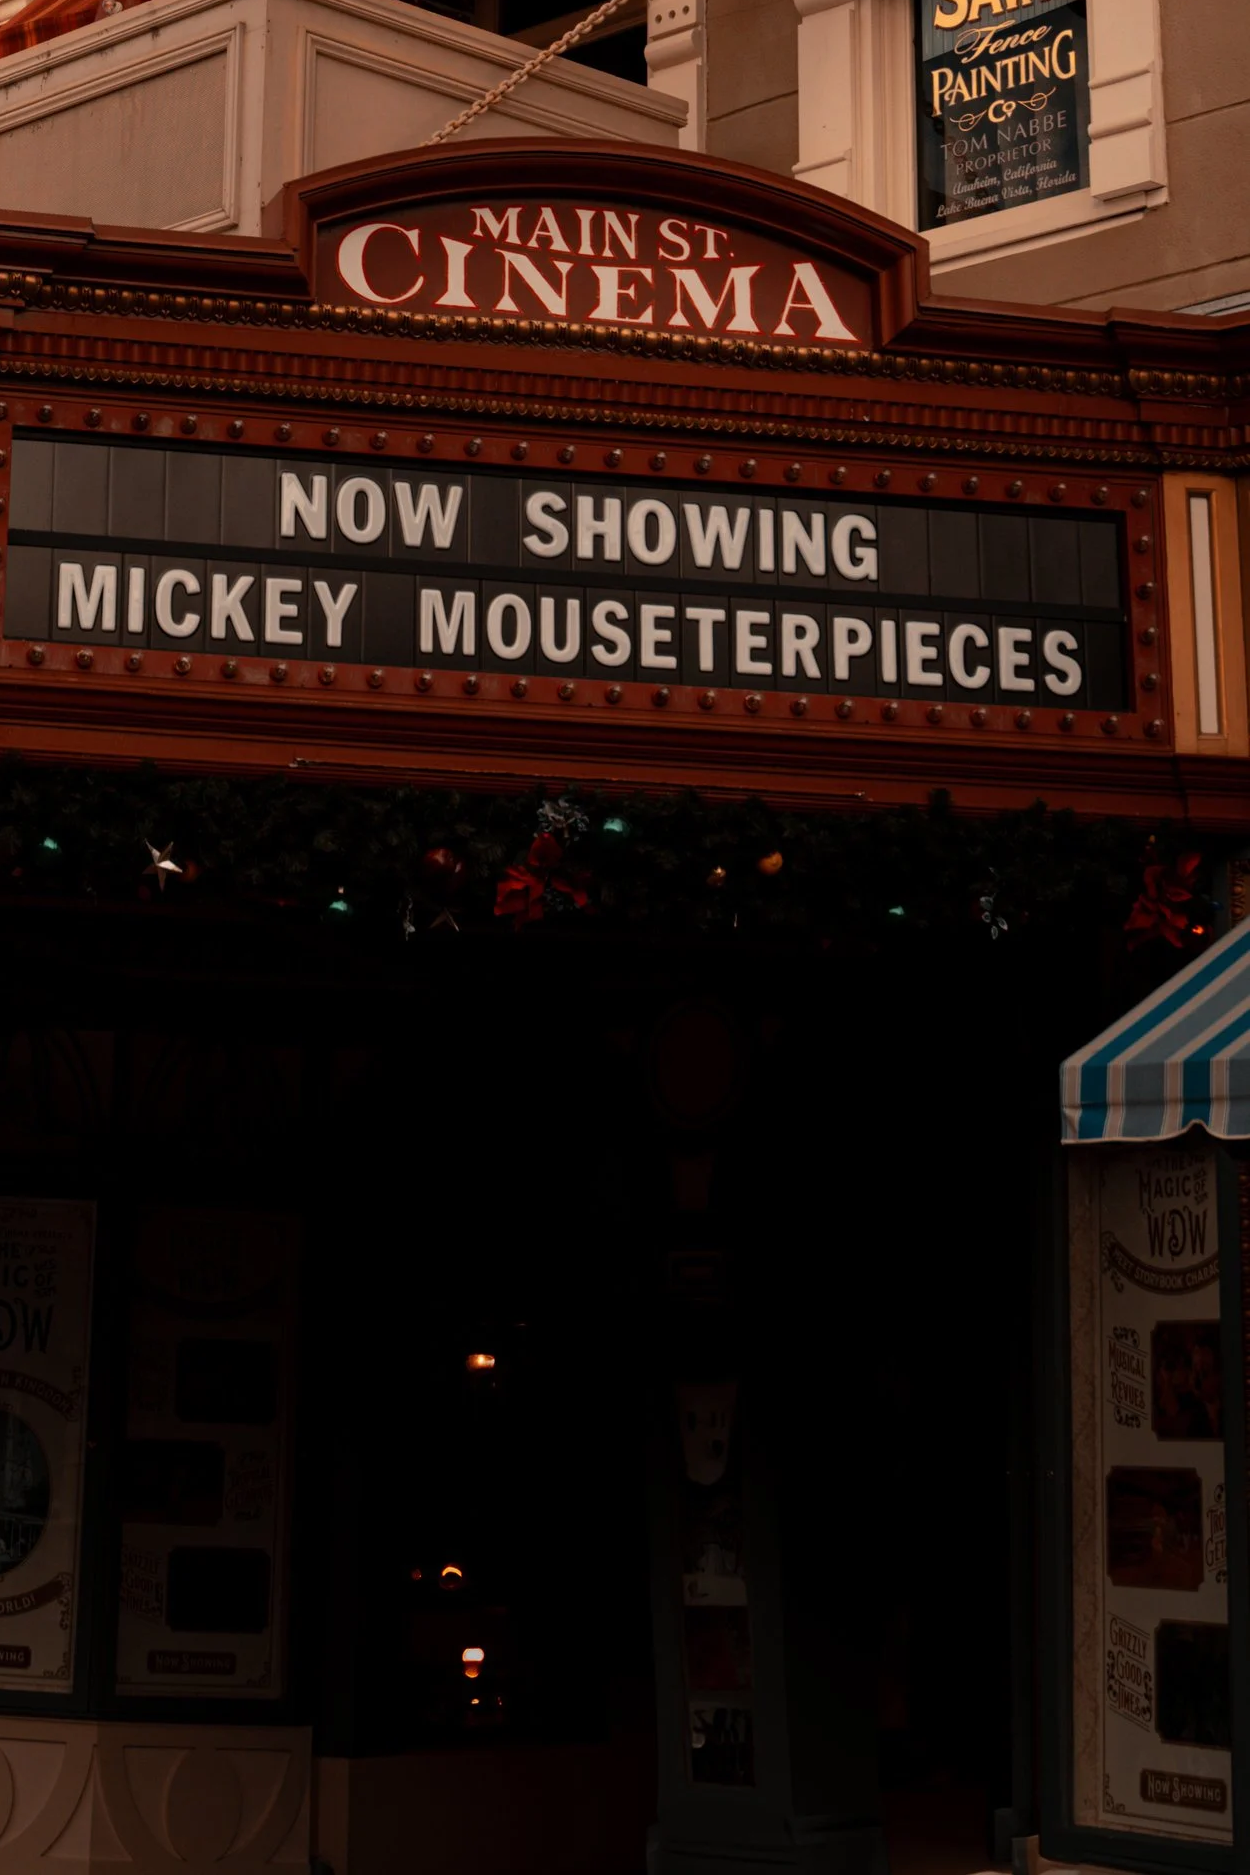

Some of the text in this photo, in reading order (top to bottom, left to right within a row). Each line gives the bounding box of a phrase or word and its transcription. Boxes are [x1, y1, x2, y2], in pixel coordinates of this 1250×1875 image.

[955, 19, 1052, 63] Fence
[931, 29, 1076, 117] PAINTING
[940, 110, 1067, 162] TOM NABBE
[956, 139, 1051, 176] PROPRIETOR
[936, 172, 1076, 218] Lake Buena Vista, Florida
[953, 158, 1057, 195] Anaheim, California
[471, 206, 734, 262] MAIN ST.
[337, 222, 859, 341] CINEMA
[280, 472, 879, 582] NOW SHOWING
[57, 562, 1082, 696] MICKEY MOUSETERPIECES
[1135, 1169, 1191, 1208] MAGIC
[1144, 1206, 1208, 1259] WDW
[1110, 1617, 1147, 1660] GRIZZLY
[1116, 1650, 1142, 1686] GOOD
[1115, 1679, 1141, 1717] TIMES
[1147, 1773, 1222, 1802] NOW SHOWING
